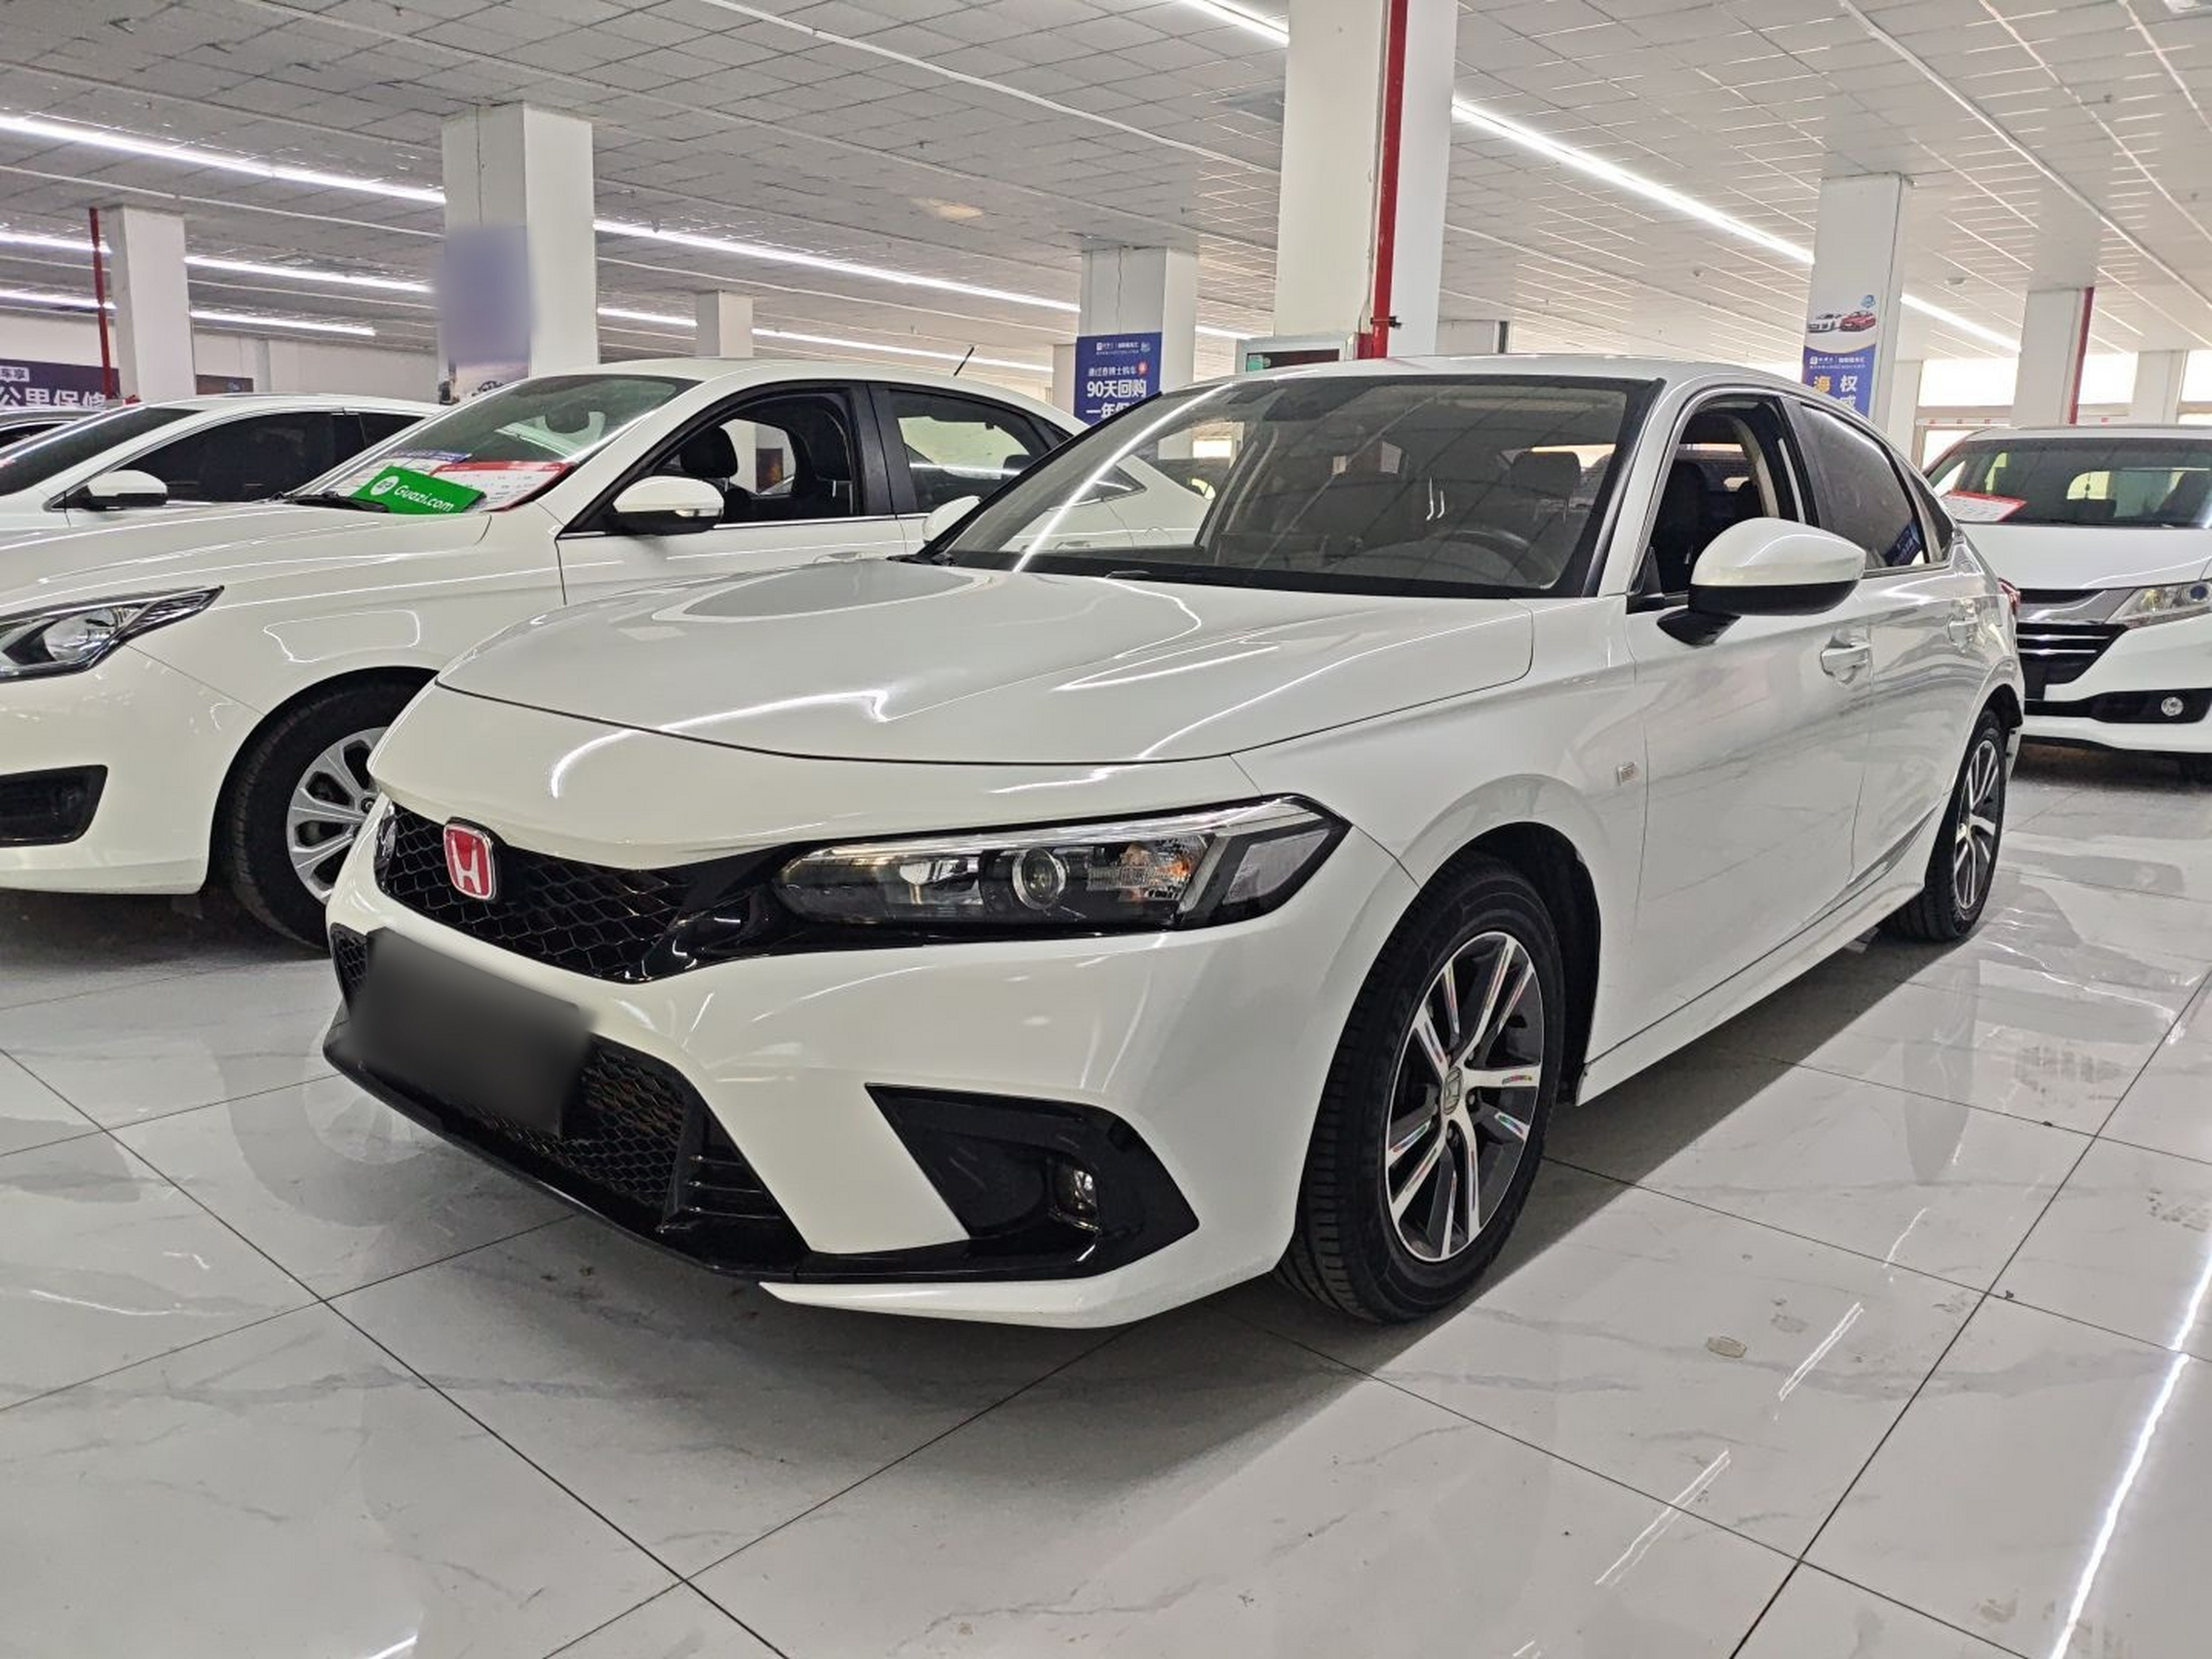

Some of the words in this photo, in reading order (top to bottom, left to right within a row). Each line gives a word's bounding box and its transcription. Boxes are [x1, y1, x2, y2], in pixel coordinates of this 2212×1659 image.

[1087, 378, 1146, 399] 90天回购
[394, 485, 454, 512] Guazi.com
